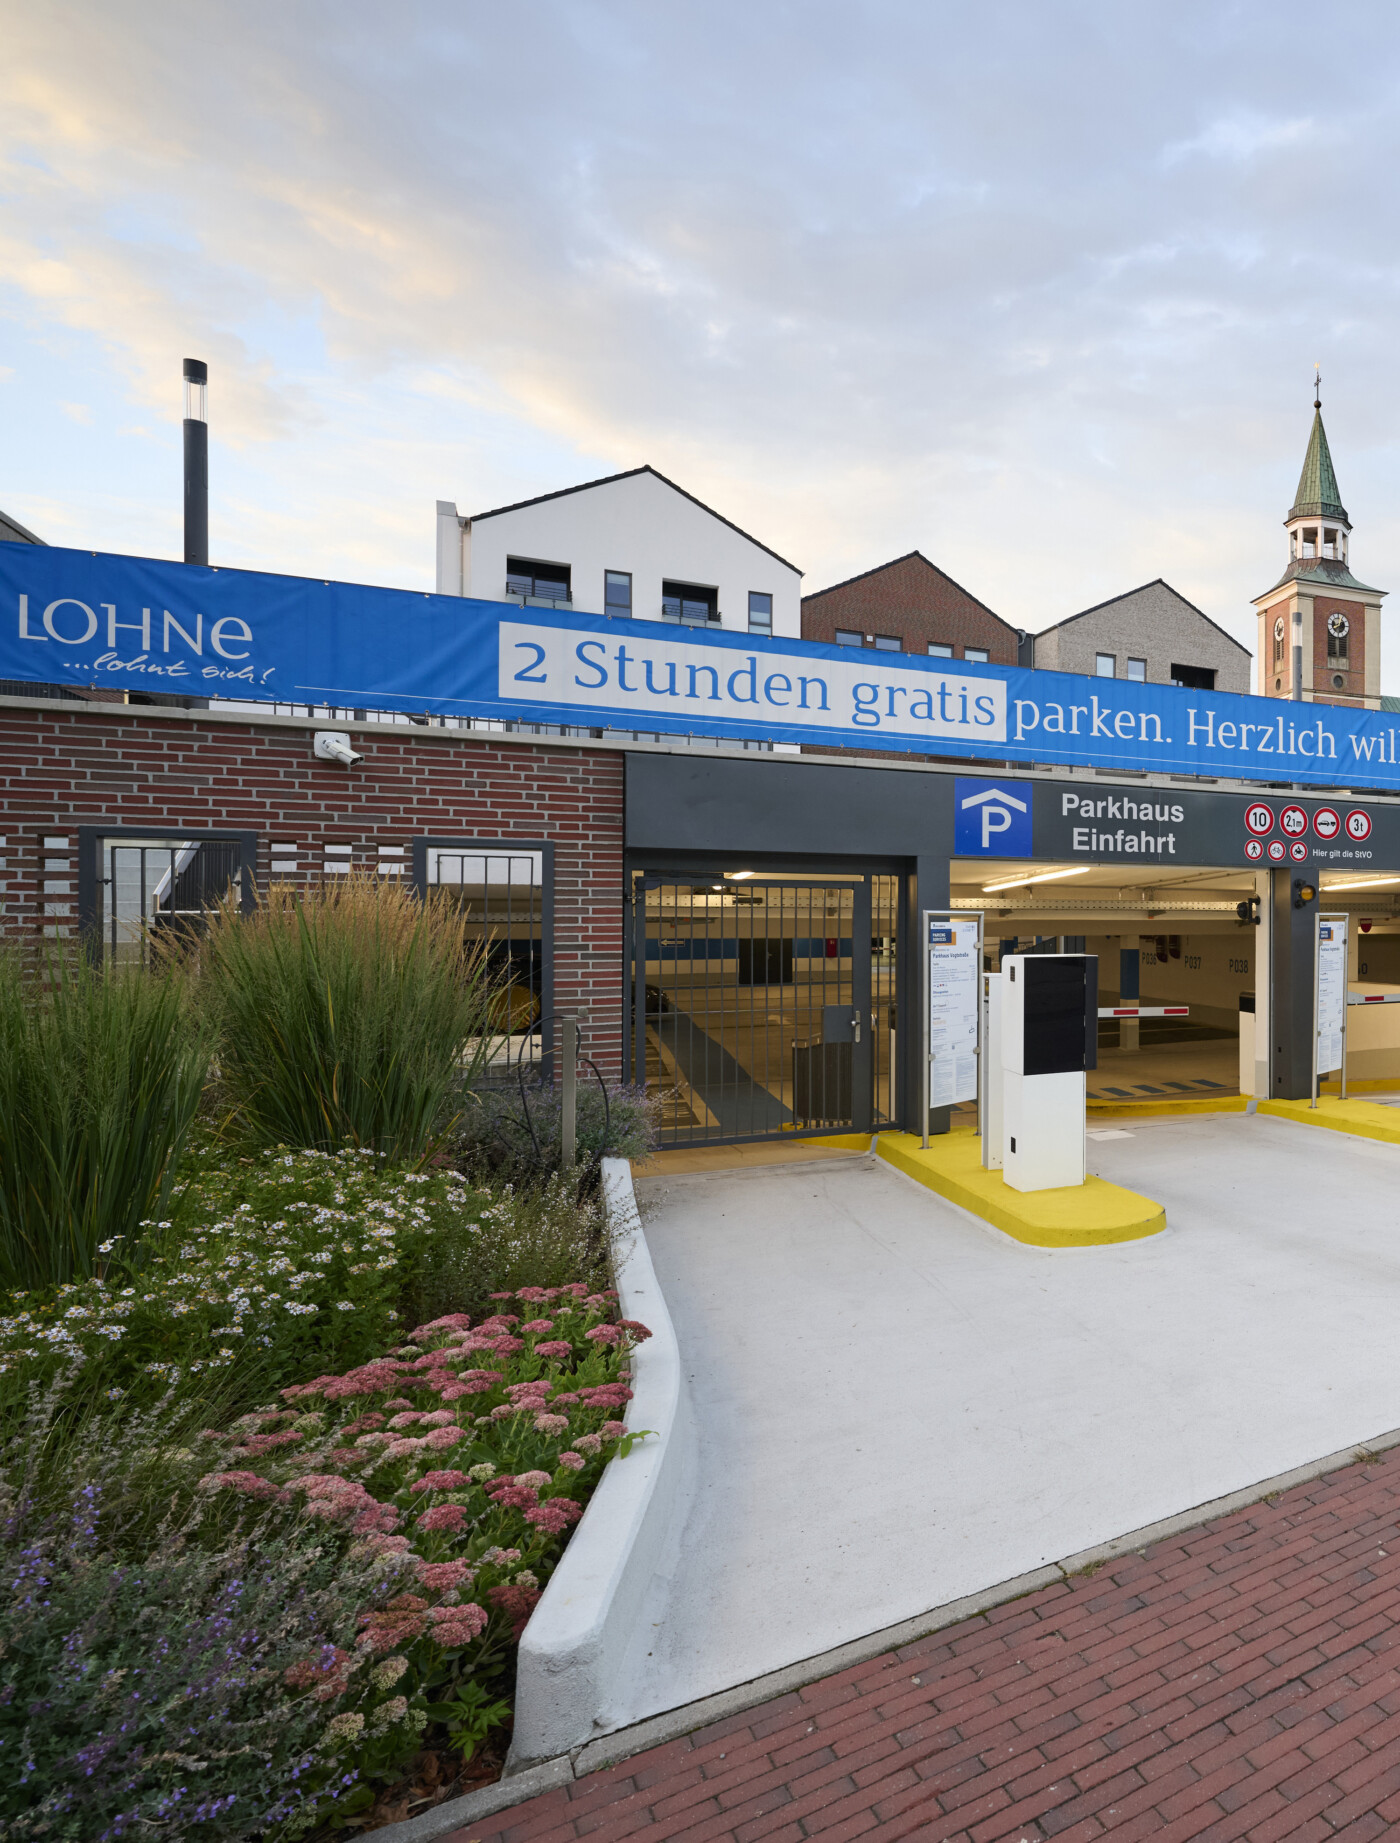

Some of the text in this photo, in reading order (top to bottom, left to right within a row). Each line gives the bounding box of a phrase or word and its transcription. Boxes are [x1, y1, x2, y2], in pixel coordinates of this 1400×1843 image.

[202, 666, 275, 685] sich!
[514, 642, 548, 683] 2
[575, 641, 831, 710] Stunden
[851, 681, 995, 727] gratis
[1013, 696, 1172, 743] parken.
[1186, 709, 1337, 758] Herzlich
[1062, 793, 1184, 822] Parkhaus
[982, 806, 1012, 848] P
[1253, 812, 1266, 827] 10
[1073, 827, 1175, 854] Einfahrt
[1312, 849, 1372, 858] Hier gilt die StVO
[1184, 955, 1201, 969] P037
[1229, 958, 1248, 973] P038
